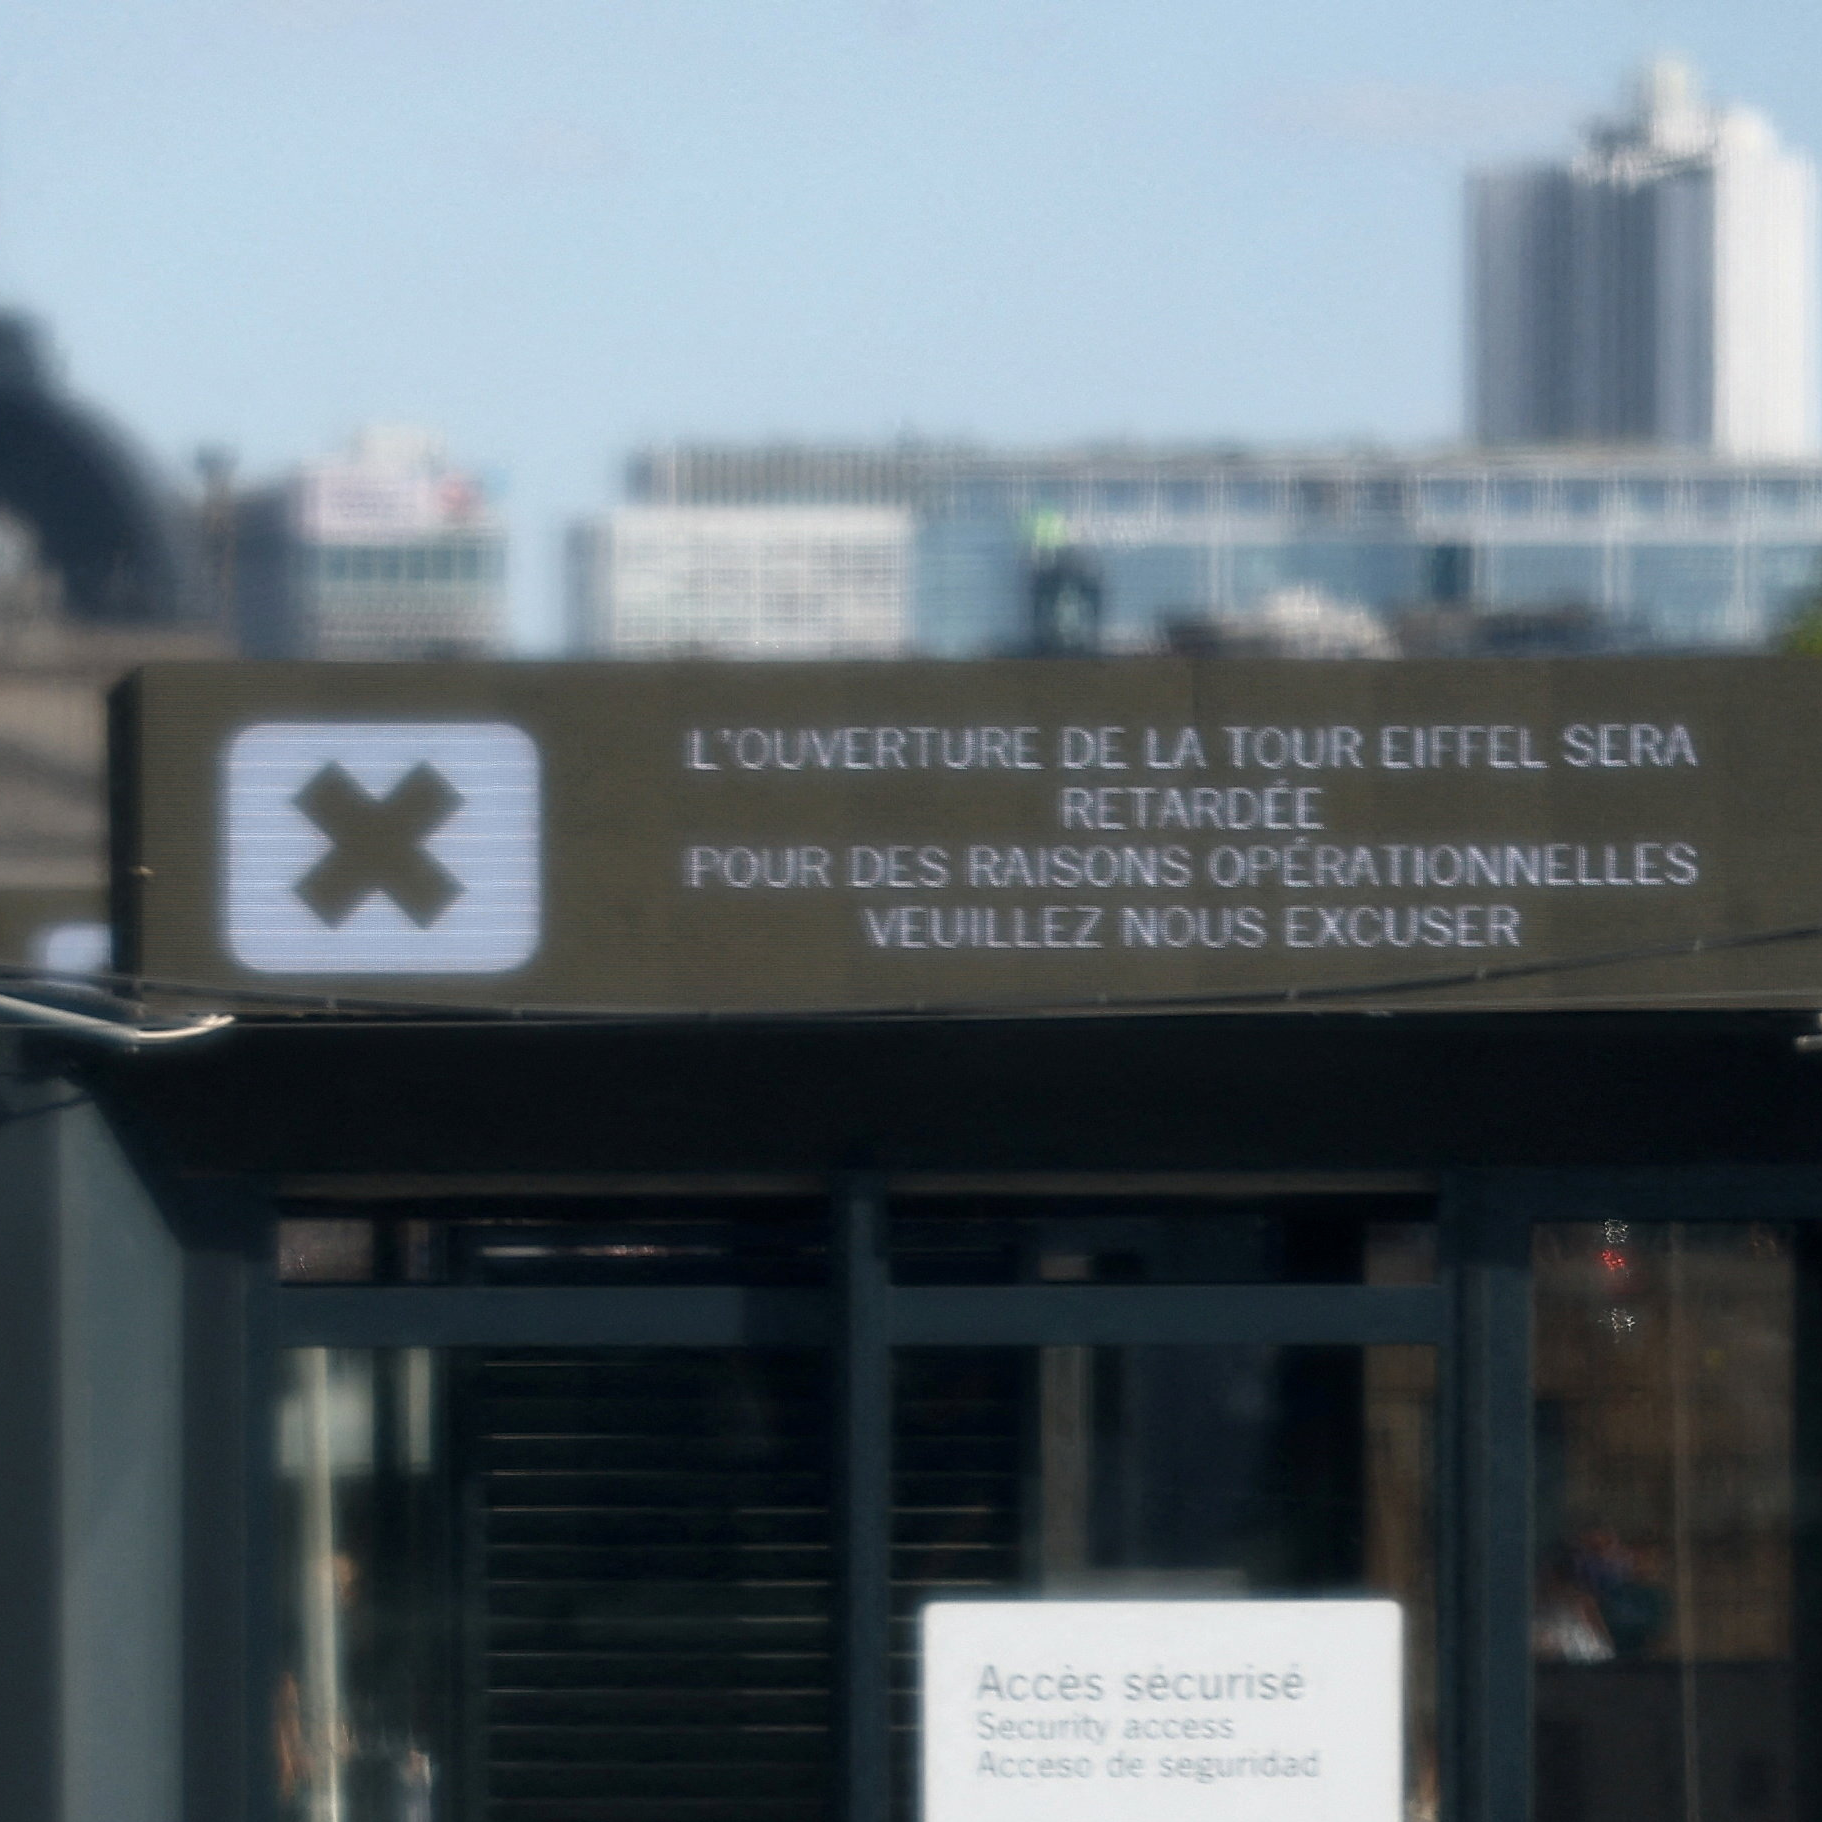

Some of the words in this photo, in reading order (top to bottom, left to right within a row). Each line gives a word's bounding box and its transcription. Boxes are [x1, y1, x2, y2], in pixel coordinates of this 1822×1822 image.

[684, 726, 1045, 770] L'OUVERTURE
[1058, 726, 1129, 770] DE
[1144, 726, 1208, 769] LA
[1222, 725, 1364, 769] TOUR
[1380, 725, 1550, 769] EIFFEL
[1561, 724, 1699, 768] SERA
[1058, 779, 1326, 830] RETARDÉE
[684, 846, 833, 888] POUR
[846, 845, 952, 888] DES
[965, 845, 1192, 888] RAISONS
[1208, 837, 1699, 887] OPÉRATIONNELLES
[861, 906, 1105, 949] VEUILLEZ
[1120, 905, 1268, 949] NOUS
[1283, 905, 1523, 948] EXCUSER
[977, 1664, 1105, 1701] Accès
[1123, 1663, 1306, 1701] sécurisé
[976, 1711, 1110, 1745] Security
[1123, 1717, 1235, 1741] access
[976, 1750, 1093, 1778] Acceso
[1106, 1750, 1146, 1778] de
[1158, 1750, 1321, 1784] seguridad
